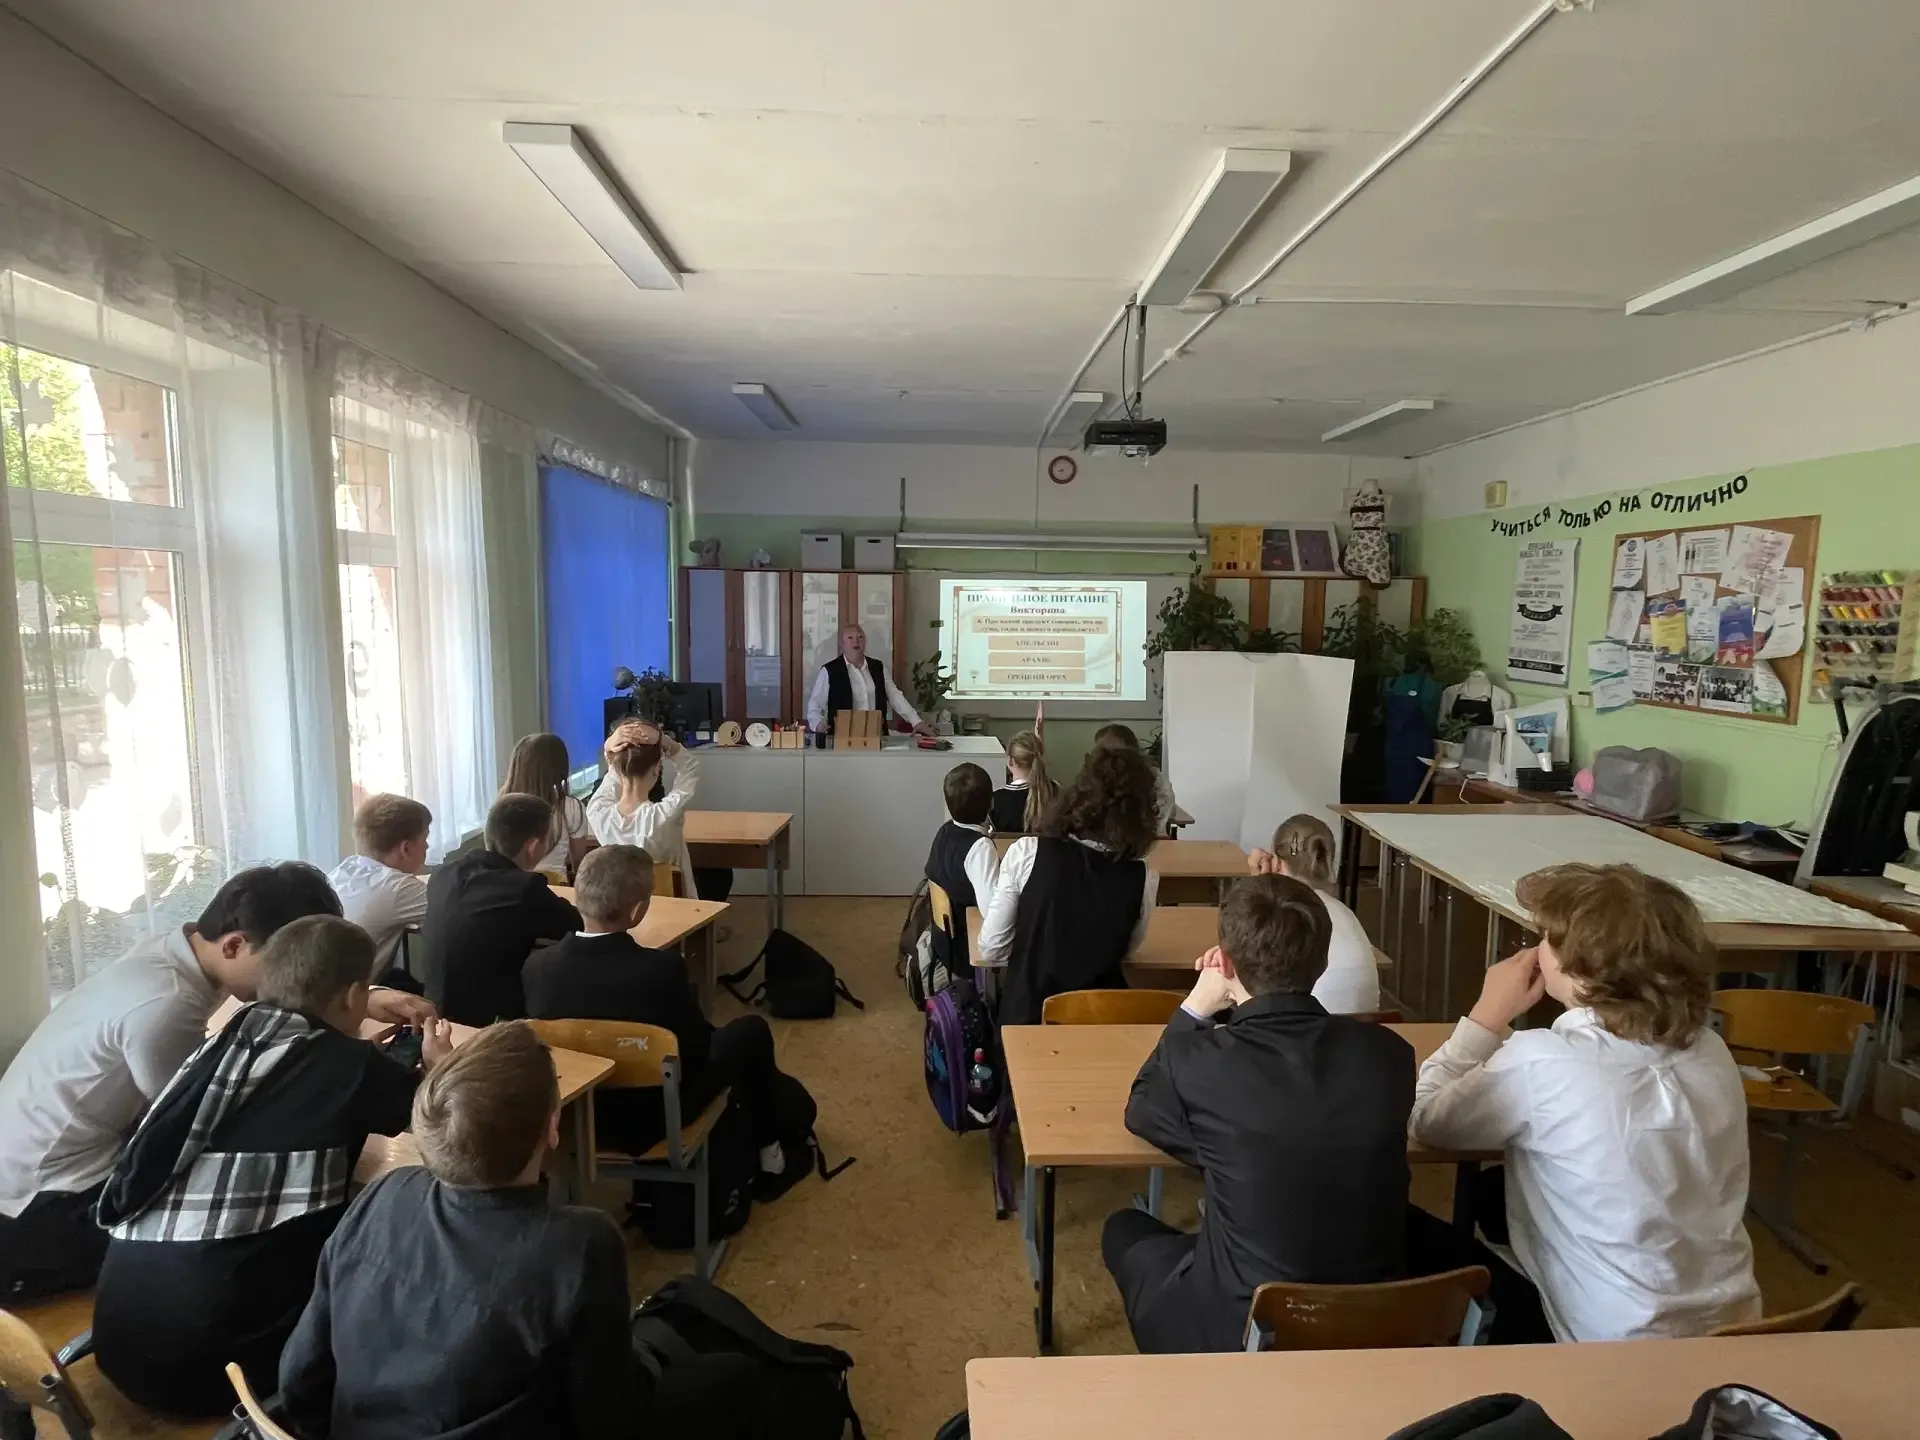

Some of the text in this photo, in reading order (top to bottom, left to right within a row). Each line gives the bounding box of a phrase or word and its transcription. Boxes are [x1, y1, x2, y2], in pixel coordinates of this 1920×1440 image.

[1491, 474, 1748, 537] УЧИТЬСЯ ТОЛЬКО НА ОТЛИЧНО
[1051, 594, 1109, 603] ПИТАНИЕ
[1010, 606, 1066, 615] Викторина
